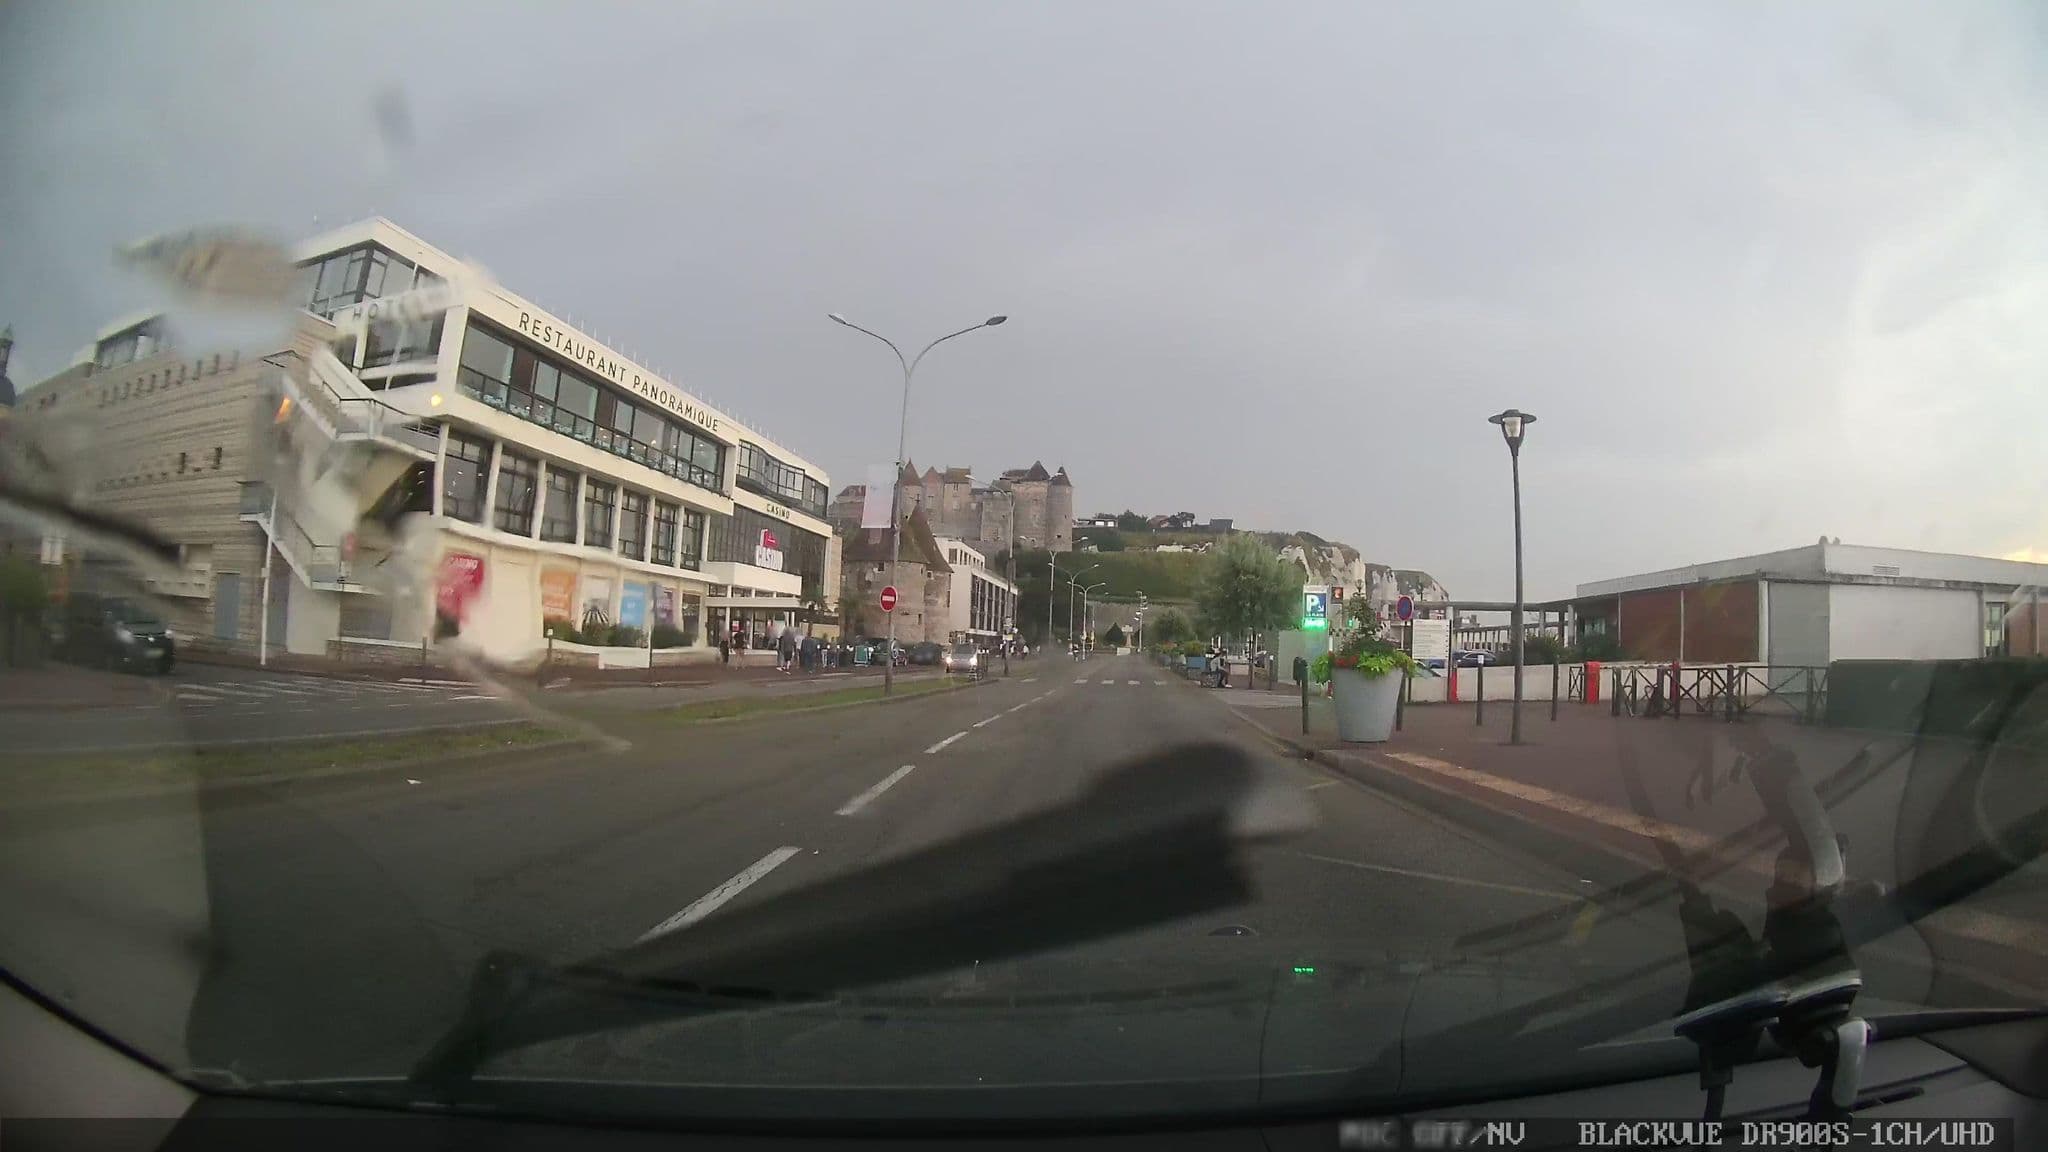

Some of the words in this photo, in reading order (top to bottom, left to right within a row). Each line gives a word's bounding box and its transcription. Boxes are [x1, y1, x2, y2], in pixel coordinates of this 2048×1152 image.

[519, 311, 627, 382] RESTAURANT
[632, 374, 720, 432] PANORAMIQUE
[766, 503, 791, 520] CASINO
